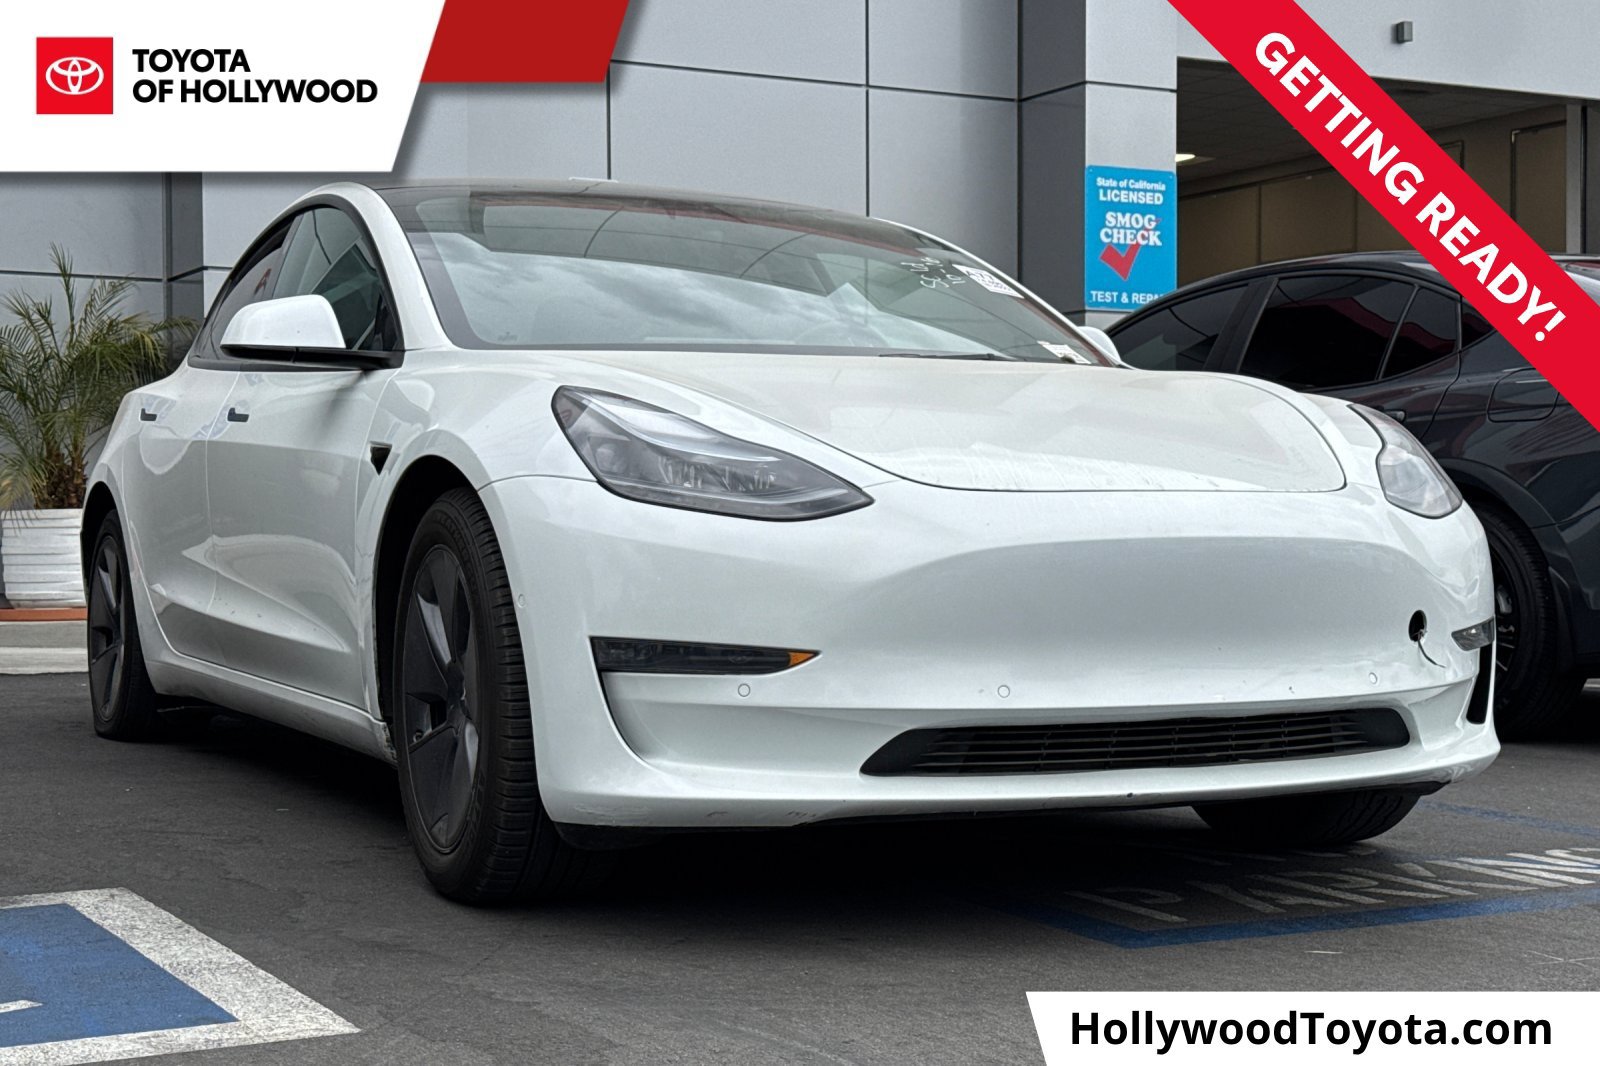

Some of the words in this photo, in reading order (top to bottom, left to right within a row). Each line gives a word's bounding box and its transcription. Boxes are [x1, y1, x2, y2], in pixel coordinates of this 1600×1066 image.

[1096, 176, 1118, 188] State
[1119, 179, 1128, 188] of
[1128, 179, 1166, 191] California
[1098, 188, 1164, 205] LICENSED
[1105, 211, 1157, 229] SMOG
[1099, 228, 1162, 246] CHECK
[1090, 290, 1119, 303] TEST
[1121, 291, 1129, 304] &
[1131, 292, 1164, 304] REPA
